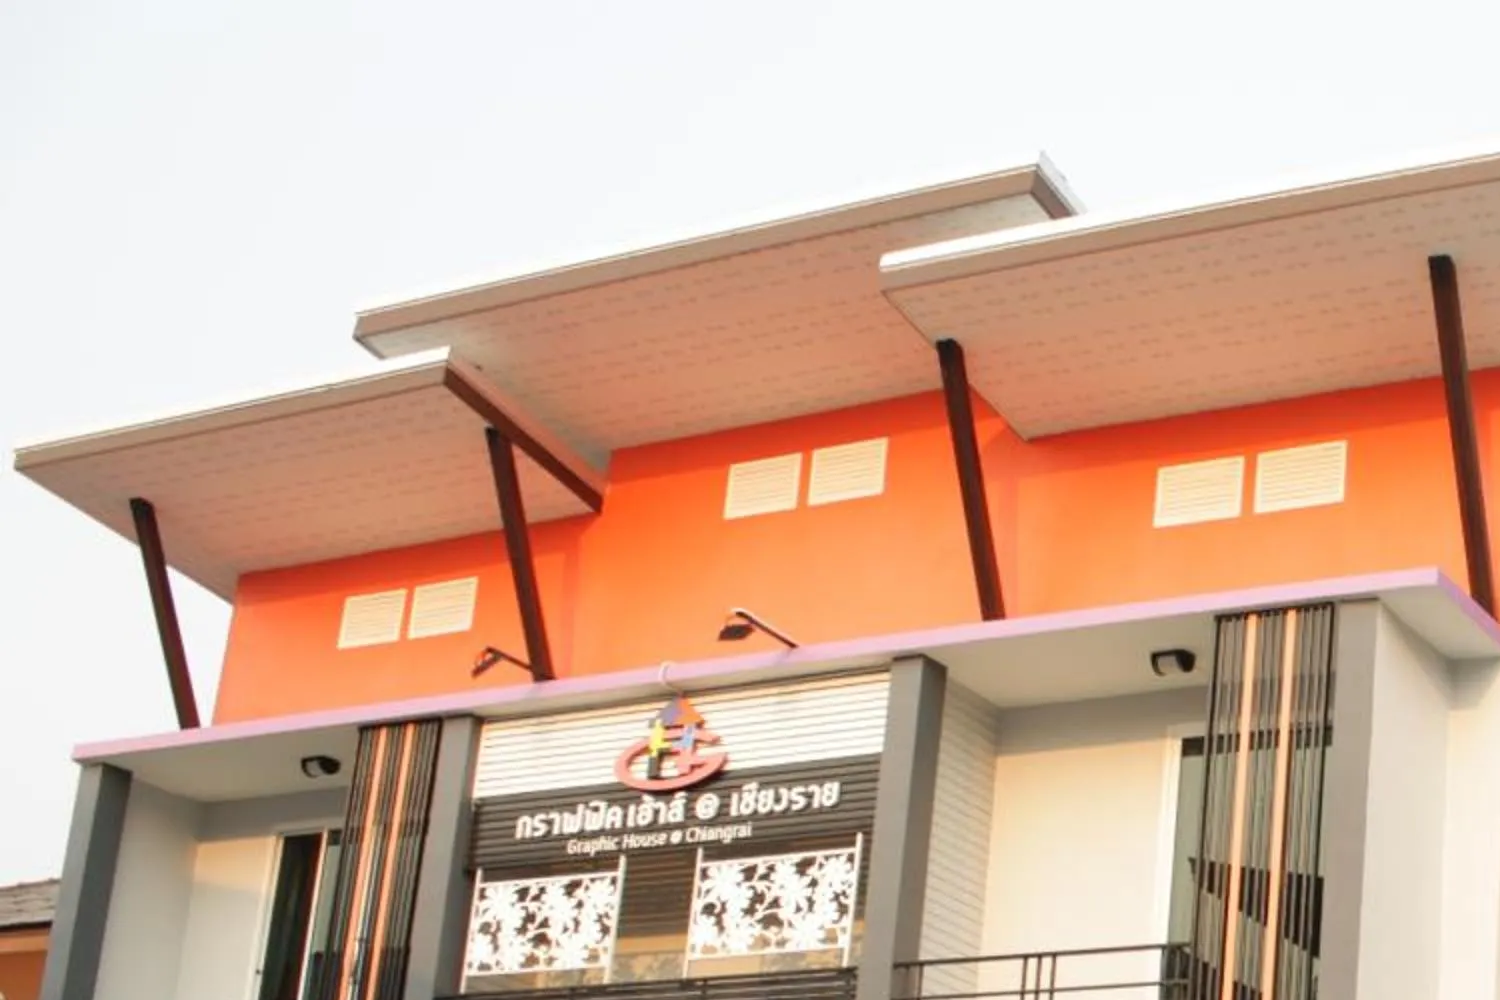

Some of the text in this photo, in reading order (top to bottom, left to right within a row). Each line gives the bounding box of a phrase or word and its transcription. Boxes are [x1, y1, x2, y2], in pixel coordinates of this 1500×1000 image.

[729, 781, 841, 818] เชียงราย
[566, 835, 620, 857] Graphic
[621, 831, 667, 850] House
[685, 820, 753, 844] Chiangrai
